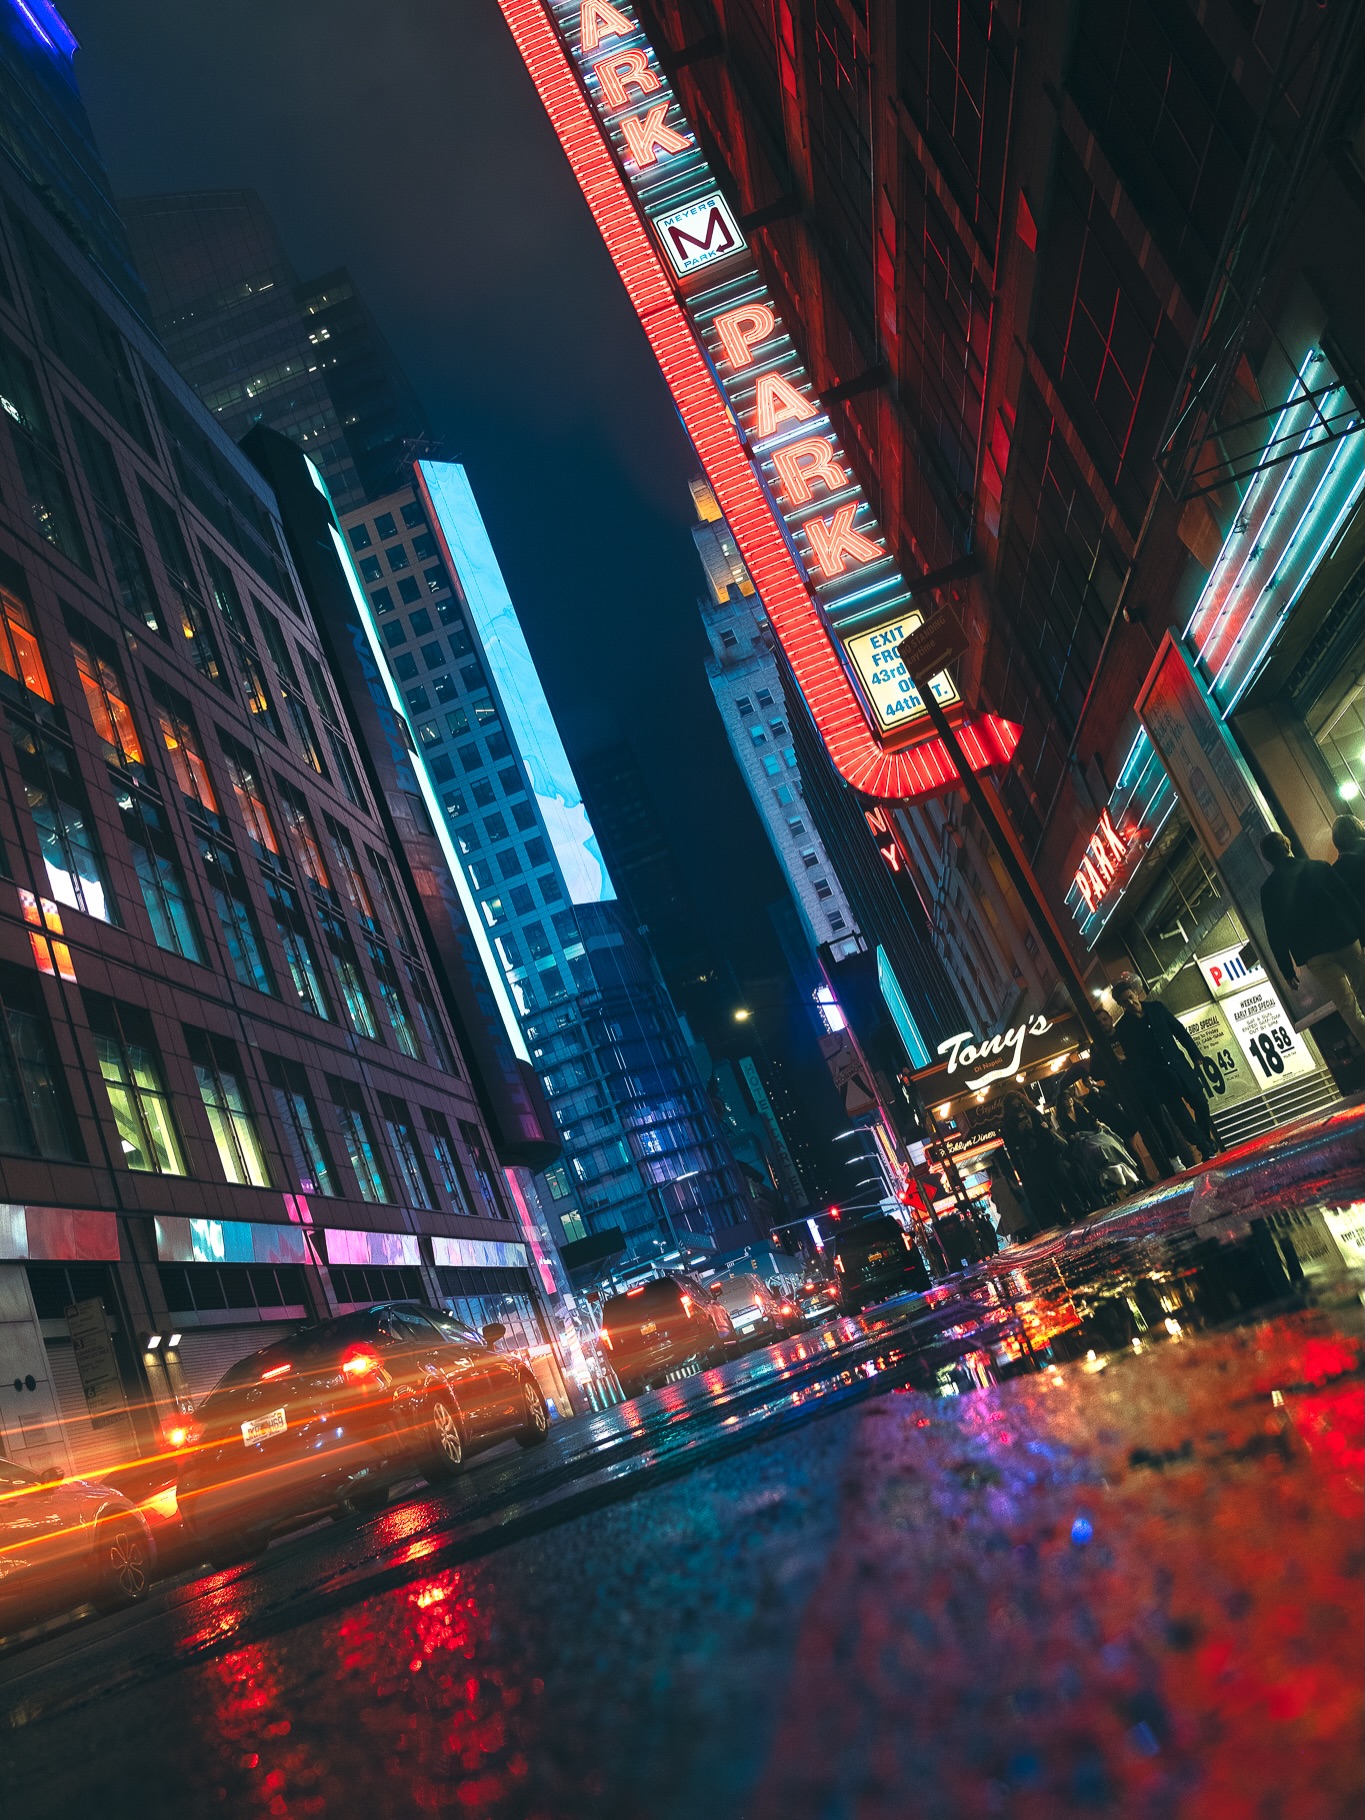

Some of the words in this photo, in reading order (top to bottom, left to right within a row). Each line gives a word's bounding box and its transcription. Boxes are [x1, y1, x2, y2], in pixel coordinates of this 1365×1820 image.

[663, 199, 716, 227] MEYERS
[683, 250, 717, 269] PARK
[712, 303, 886, 578] PARK
[870, 625, 905, 650] EXIT
[900, 643, 912, 657] NO
[911, 615, 946, 649] STANDING
[871, 647, 900, 667] FRO
[907, 639, 936, 667] Anytime
[871, 662, 907, 685] 43rd
[346, 622, 413, 791] NASDAQ
[885, 695, 922, 717] 44th
[932, 683, 948, 697] T.
[1074, 806, 1127, 914] PARK
[430, 865, 545, 1141] MARKETSITE
[1233, 1009, 1247, 1021] EARLY
[1247, 1004, 1258, 1015] BIRD
[1257, 998, 1276, 1011] SPECIAL
[1240, 994, 1263, 1009] WEEKEND
[1188, 1022, 1200, 1035] BIRD
[1199, 1015, 1220, 1030] SPECIAL
[937, 1014, 1054, 1091] Tony's
[1217, 1048, 1235, 1071] 43
[1248, 1032, 1285, 1078] 18
[1270, 1025, 1292, 1050] 58
[835, 1062, 864, 1087] MORMON
[973, 1065, 983, 1073] Di
[982, 1057, 1003, 1070] Napoli
[972, 1130, 997, 1145] Diner
